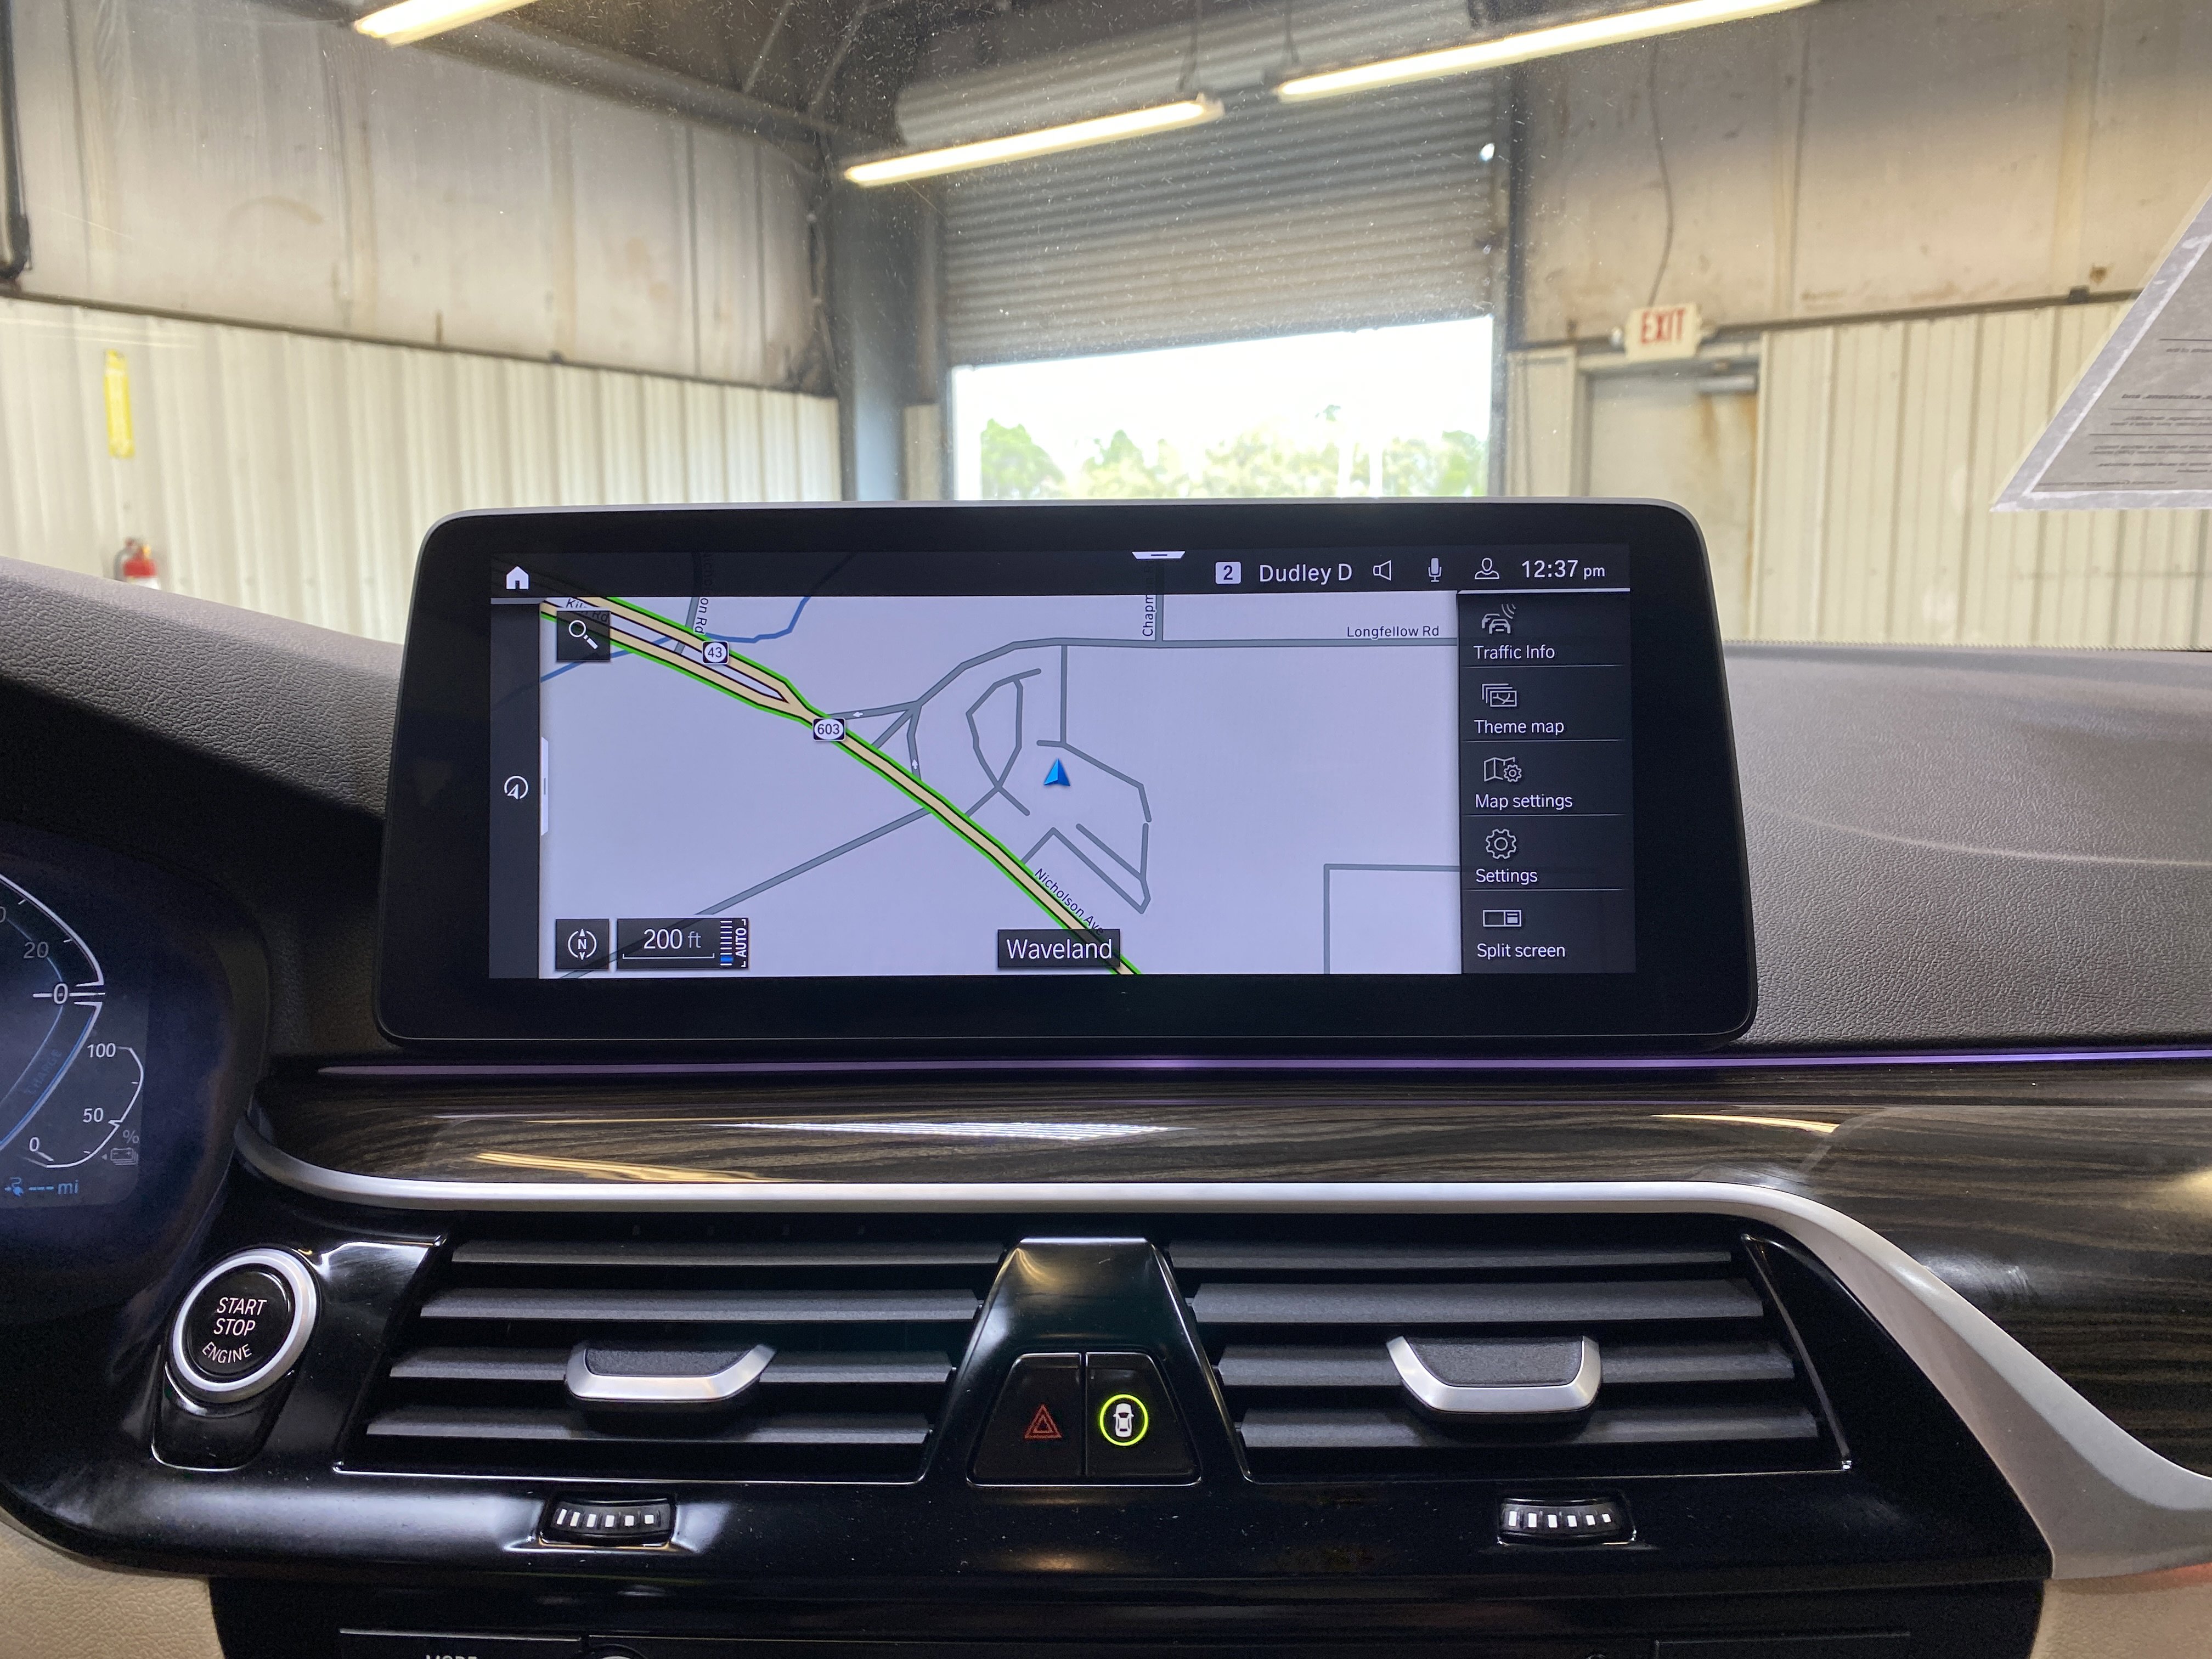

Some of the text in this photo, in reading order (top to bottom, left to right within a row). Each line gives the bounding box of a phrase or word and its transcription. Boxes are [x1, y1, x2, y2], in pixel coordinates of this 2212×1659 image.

[1640, 307, 1686, 344] EXIT
[1223, 563, 1353, 585] 2 Dudley D
[1521, 559, 1606, 581] 12:37 pm
[694, 617, 708, 634] Rd
[1347, 625, 1440, 639] Longfellow Rd
[707, 647, 722, 658] 43
[1474, 645, 1555, 659] Traffic Info
[817, 724, 840, 735] 603
[1474, 720, 1565, 735] Theme map
[1475, 794, 1573, 810] Map settings
[1476, 868, 1538, 885] Settings
[1034, 868, 1104, 935] Nicholson Ave
[23, 941, 49, 959] 20
[643, 927, 747, 958] 200 ft AUTO
[1006, 938, 1113, 960] Waveland
[1477, 943, 1566, 959] Split screen
[53, 983, 69, 1005] 0
[87, 1042, 116, 1058] 100
[82, 1107, 104, 1123] 50
[29, 1137, 41, 1152] 0
[122, 1130, 139, 1144] %
[58, 1180, 79, 1195] mi
[216, 1296, 268, 1316] START
[213, 1318, 256, 1336] STOP
[201, 1341, 252, 1364] ENGINE
